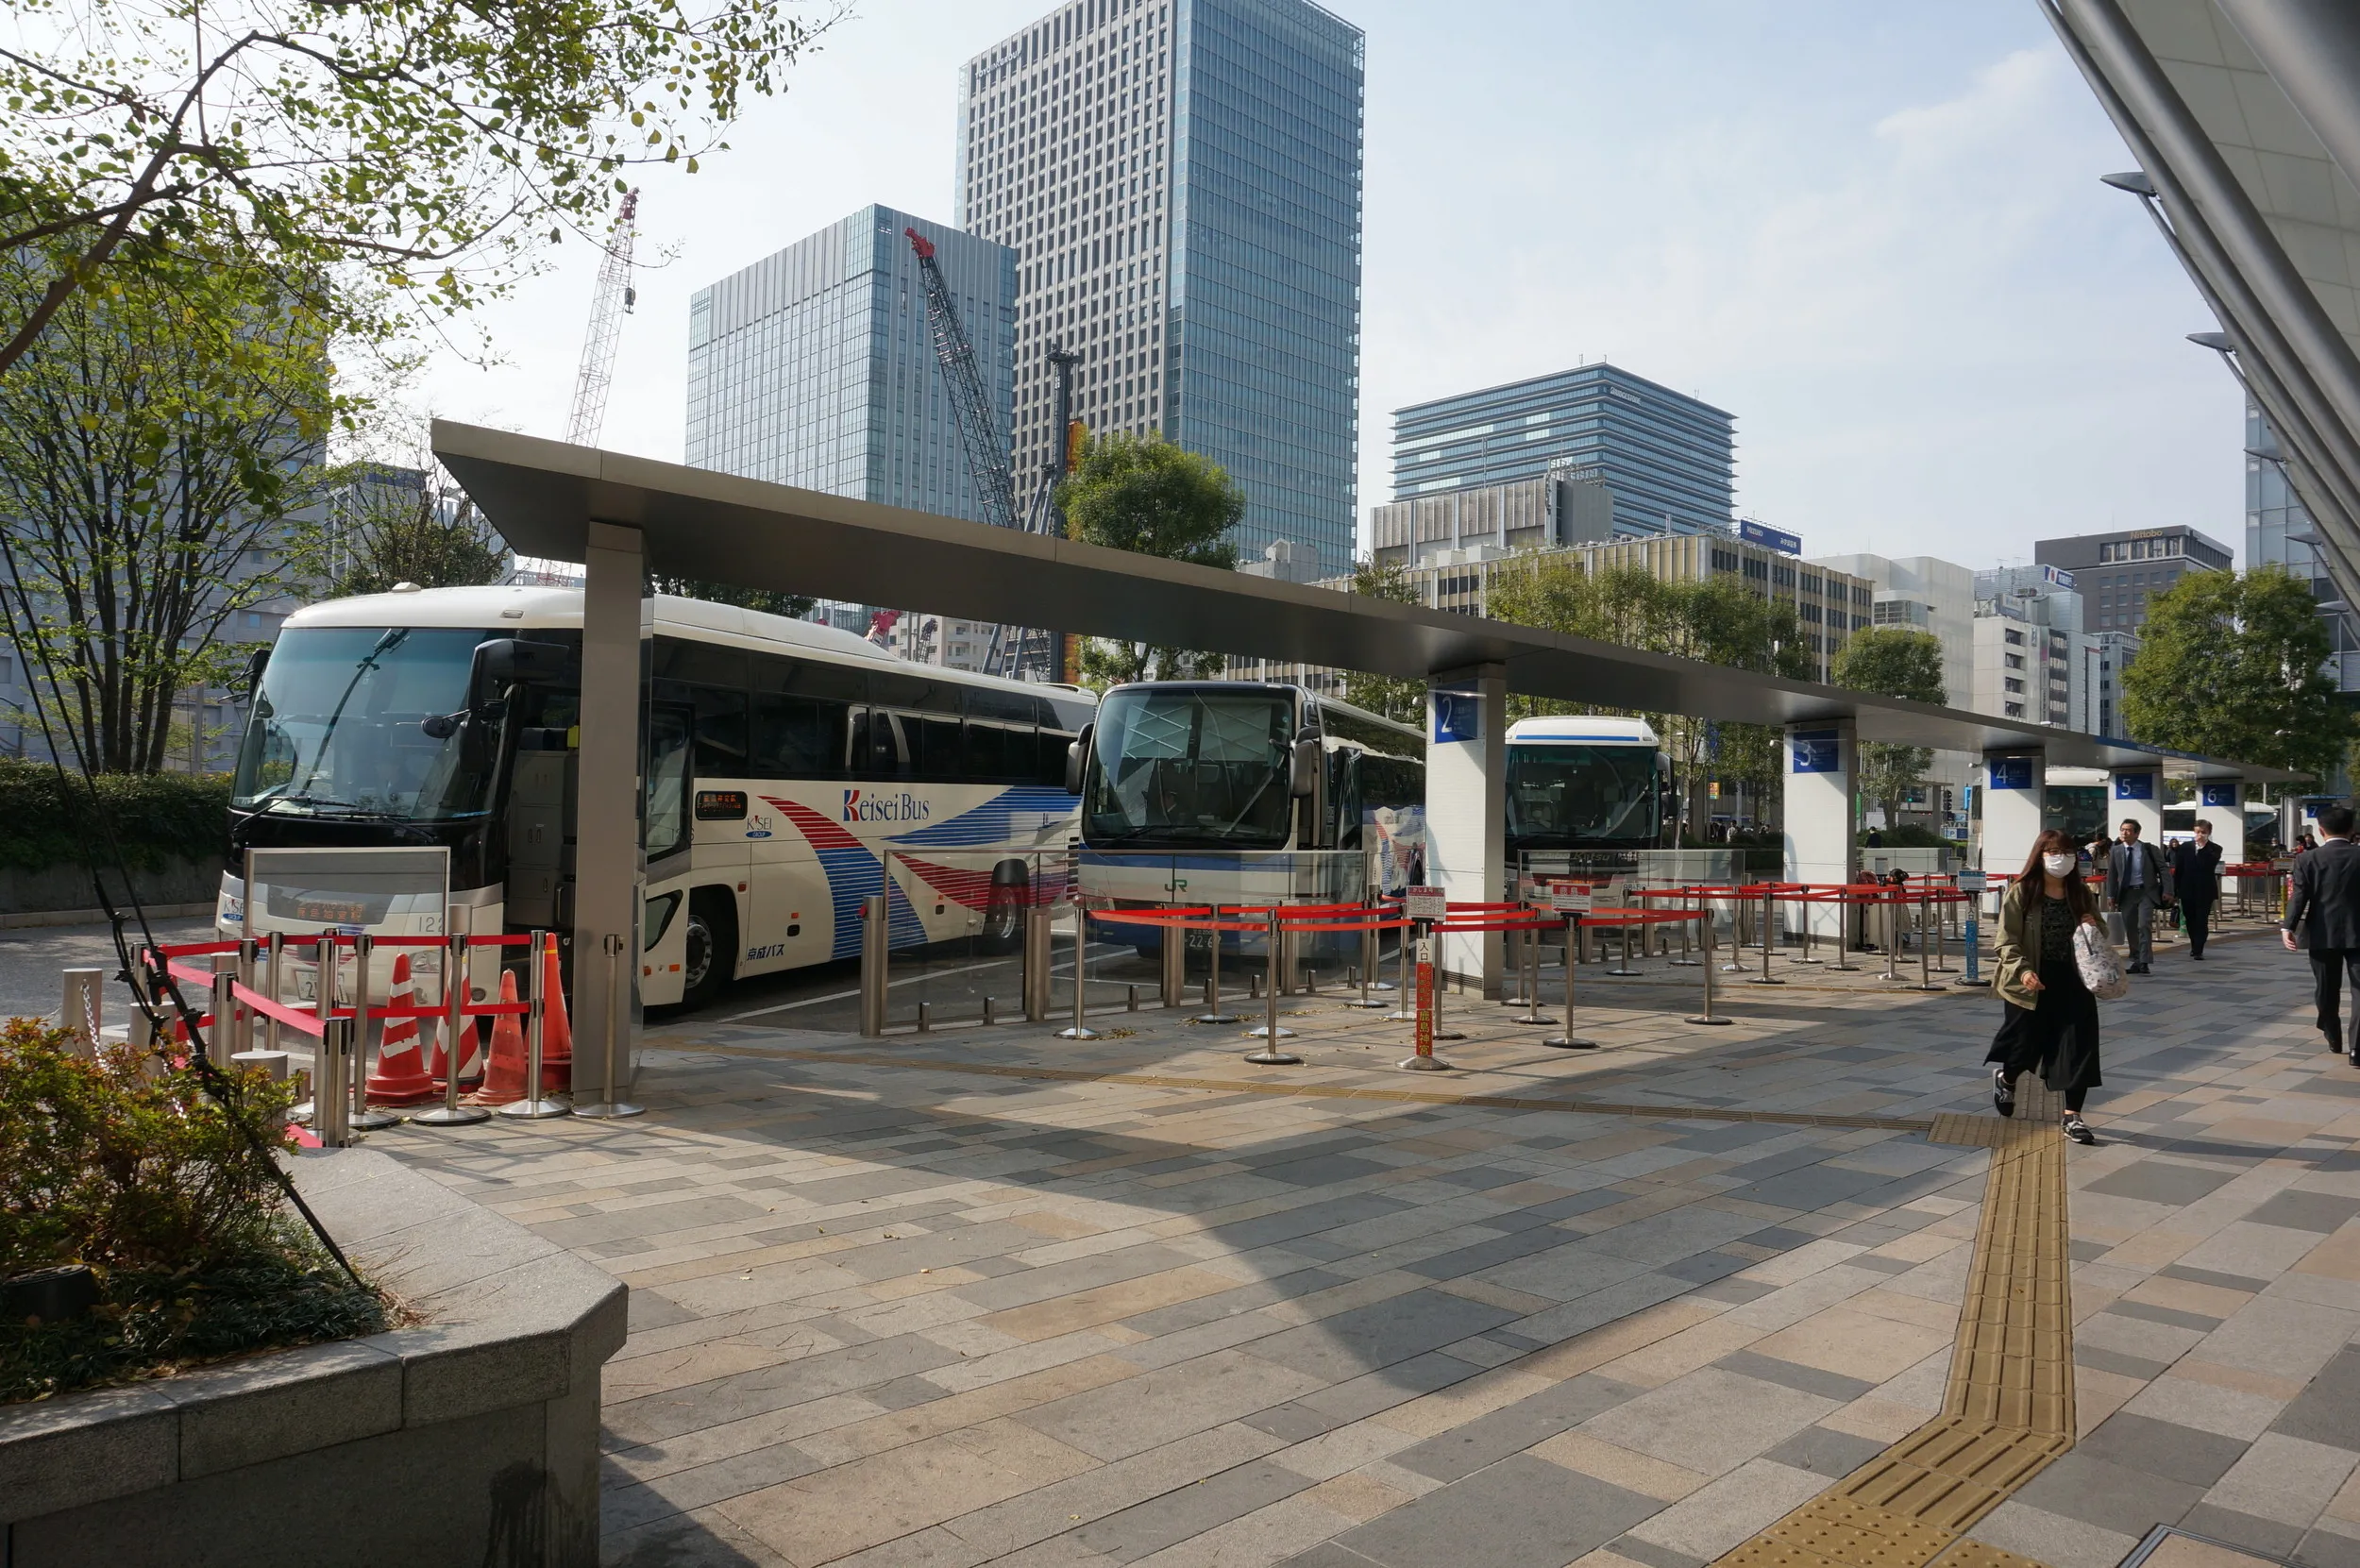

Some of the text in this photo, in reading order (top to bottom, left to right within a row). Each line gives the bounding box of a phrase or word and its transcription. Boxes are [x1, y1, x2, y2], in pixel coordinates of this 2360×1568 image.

[2130, 530, 2163, 539] Nittobo
[1441, 696, 1452, 733] 2
[1800, 742, 1812, 767] 3
[1996, 763, 2008, 784] 4
[2121, 778, 2131, 796] 5
[2208, 788, 2217, 803] 6
[843, 789, 930, 821] Keisei Bus
[2310, 805, 2318, 817] 7
[1164, 879, 1188, 892] JR
[224, 899, 244, 914] K'SE
[1967, 908, 1974, 920] 入口
[747, 944, 784, 961] 京成バス
[1419, 942, 1428, 961] 入口
[1419, 1010, 1429, 1055] 鹿島神宮
